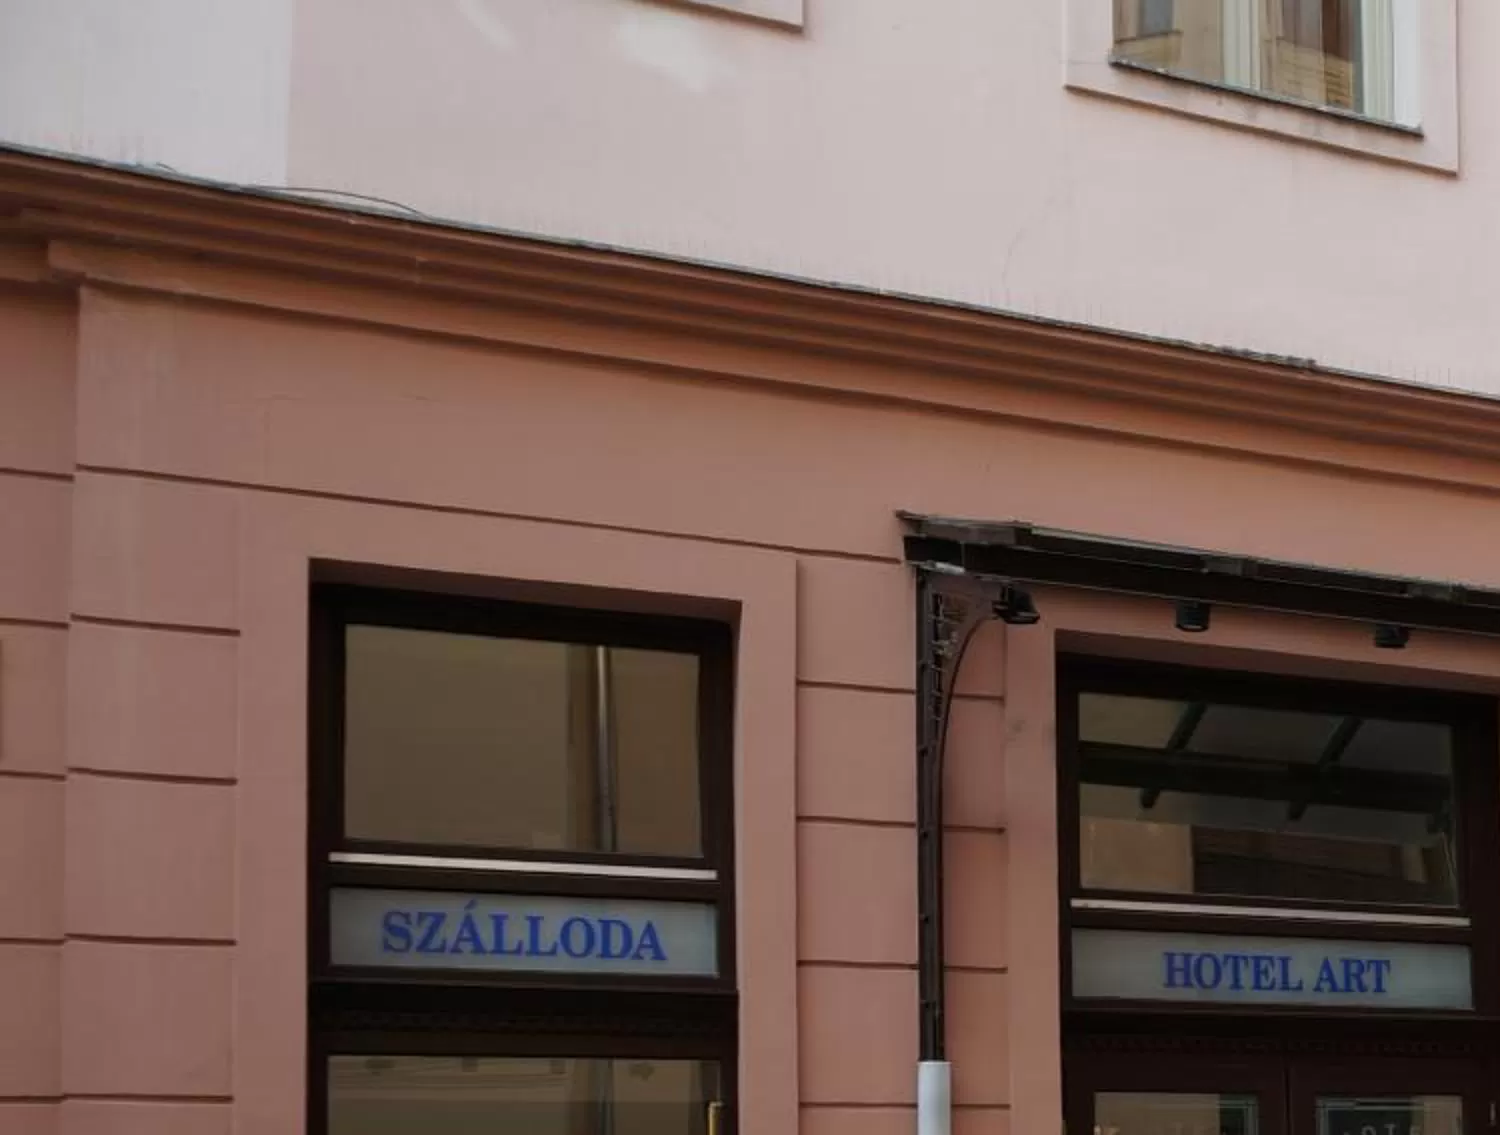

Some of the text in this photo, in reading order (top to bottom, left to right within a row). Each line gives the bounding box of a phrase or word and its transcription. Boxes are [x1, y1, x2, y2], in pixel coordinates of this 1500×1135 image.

[381, 899, 668, 962] SZÁLLODA
[1162, 951, 1391, 994] HOTEL ART
